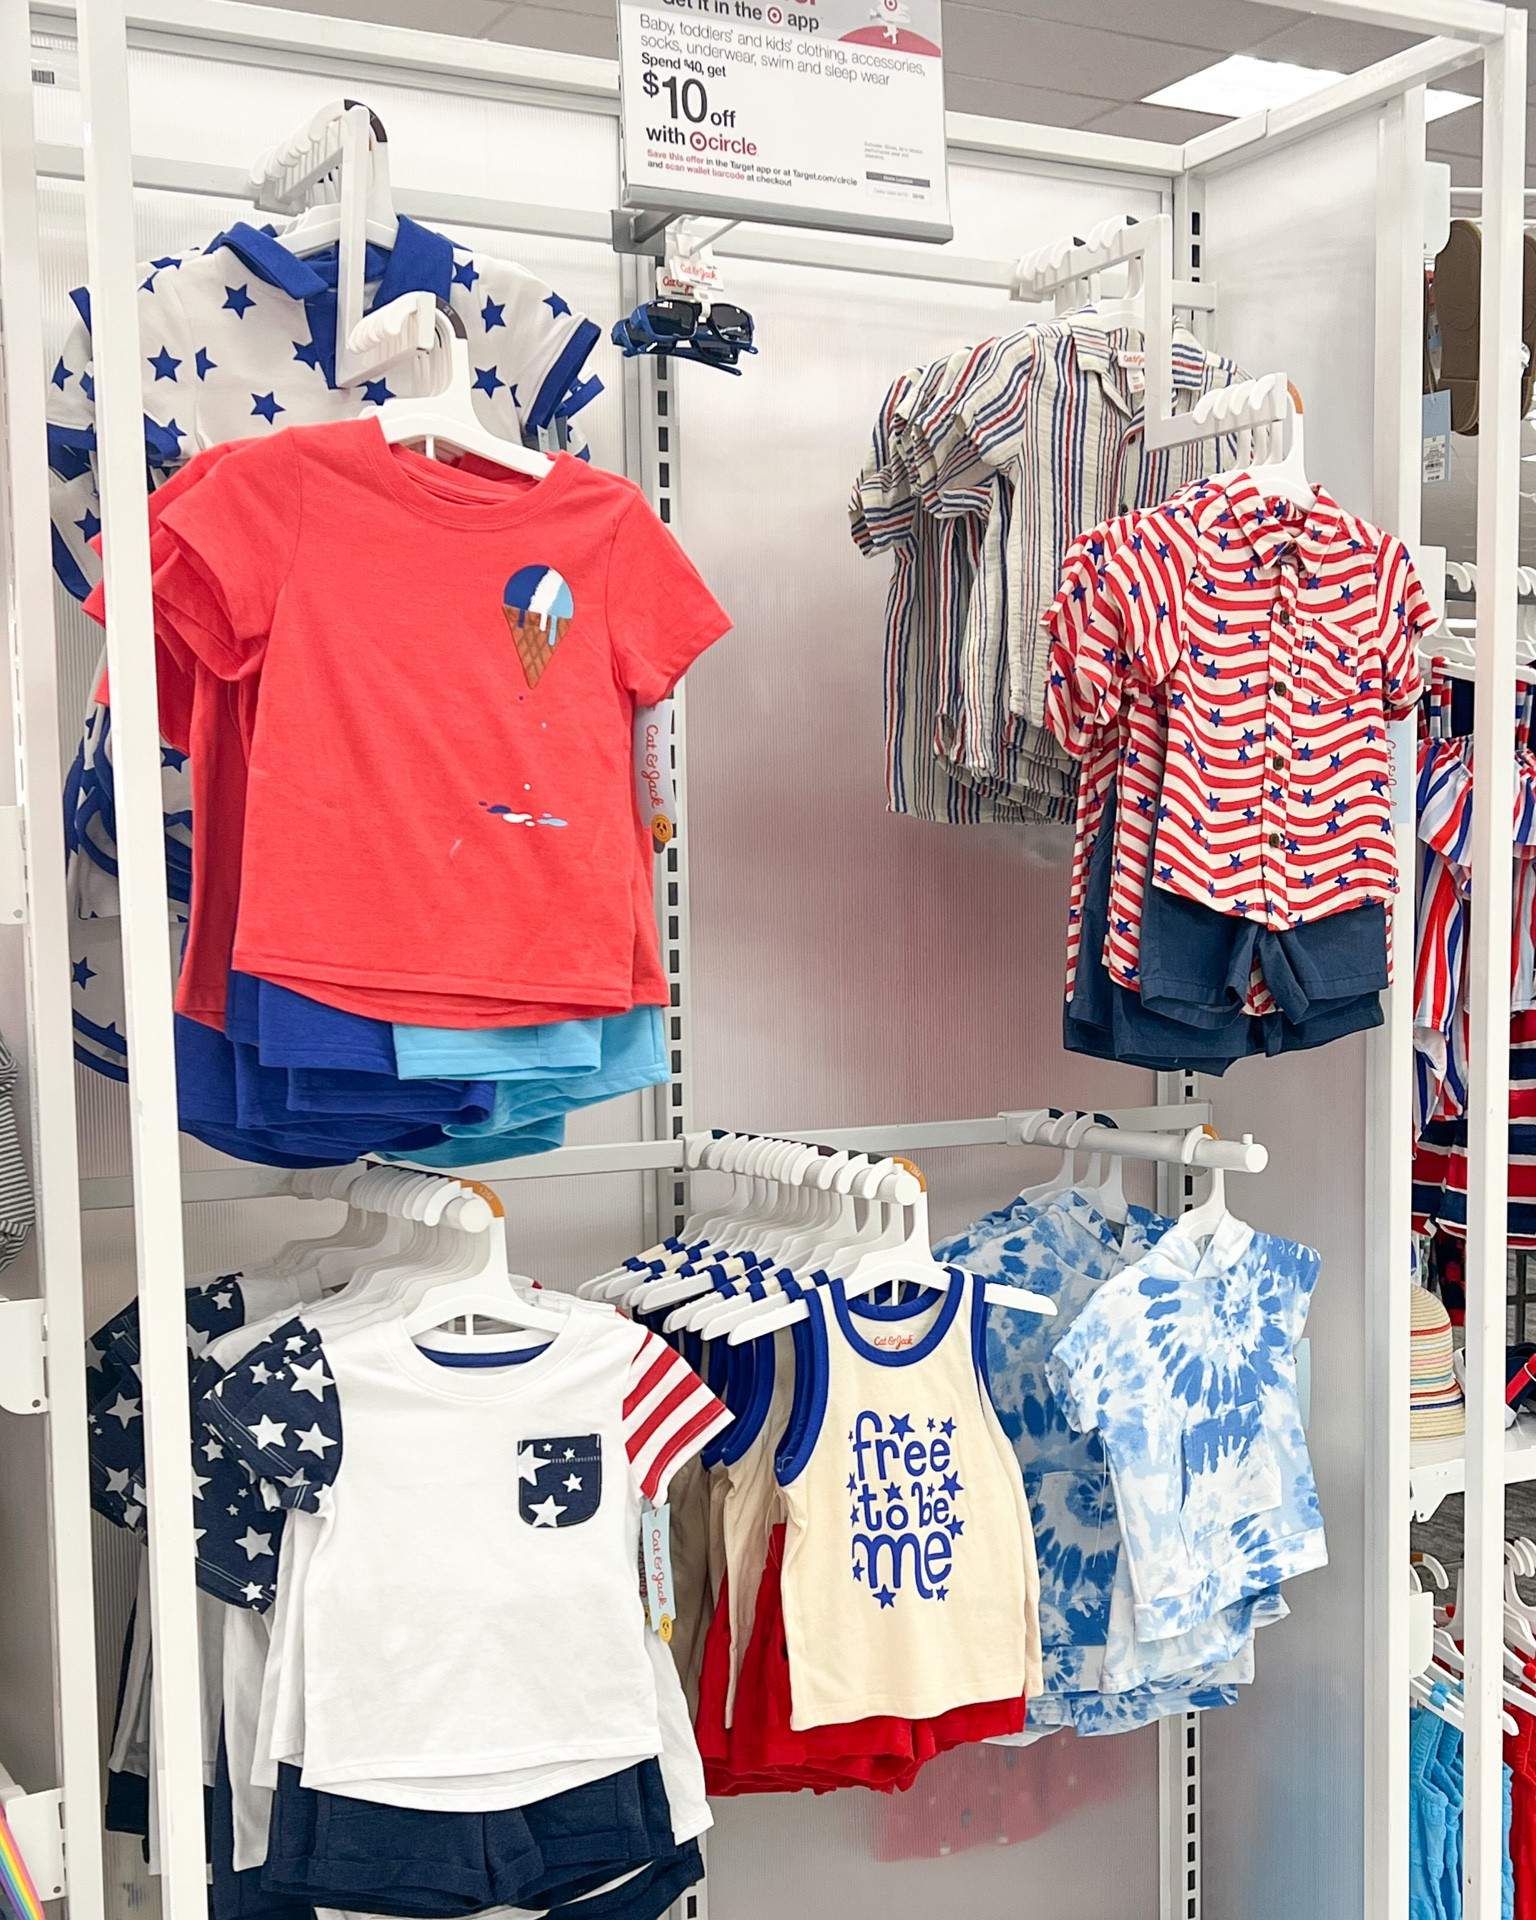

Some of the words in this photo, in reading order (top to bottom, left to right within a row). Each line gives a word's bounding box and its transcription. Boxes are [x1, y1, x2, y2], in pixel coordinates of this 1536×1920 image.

[714, 0, 730, 15] in
[734, 1, 763, 21] the
[787, 13, 820, 33] app
[640, 13, 676, 36] Baby,
[737, 31, 762, 48] and
[796, 42, 848, 65] clothing,
[851, 52, 926, 77] accessories,
[640, 34, 682, 54] socks,
[686, 42, 757, 67] underwear,
[760, 54, 794, 70] swim
[797, 60, 821, 75] and
[824, 63, 858, 83] sleep
[860, 70, 891, 86] wear
[641, 51, 681, 70] Spend
[683, 58, 705, 76] $40,
[707, 64, 727, 78] get
[642, 69, 708, 123] $10
[710, 109, 737, 128] off
[646, 125, 686, 145] with
[708, 133, 758, 156] circle
[647, 149, 668, 160] Save
[669, 152, 684, 162] this
[685, 155, 704, 165] offer
[706, 157, 714, 166] in
[715, 158, 728, 168] the
[730, 160, 755, 172] Target
[756, 166, 771, 175] app
[773, 168, 781, 176] or
[783, 169, 791, 177] at
[793, 169, 858, 187] Target.com/circle
[647, 160, 663, 169] and
[665, 162, 685, 172] scan
[687, 164, 711, 176] wallet
[712, 168, 745, 181] barcode
[746, 174, 755, 182] at
[756, 174, 793, 187] checkout
[646, 724, 659, 751] Cat
[640, 770, 664, 809] Jack
[874, 1336, 887, 1346] Cat
[895, 1334, 914, 1350] Jack
[852, 1410, 951, 1481] free
[857, 1483, 909, 1532] to
[911, 1481, 950, 1529] be
[652, 1529, 662, 1556] Cat
[852, 1530, 953, 1600] me
[651, 1571, 668, 1609] Jack
